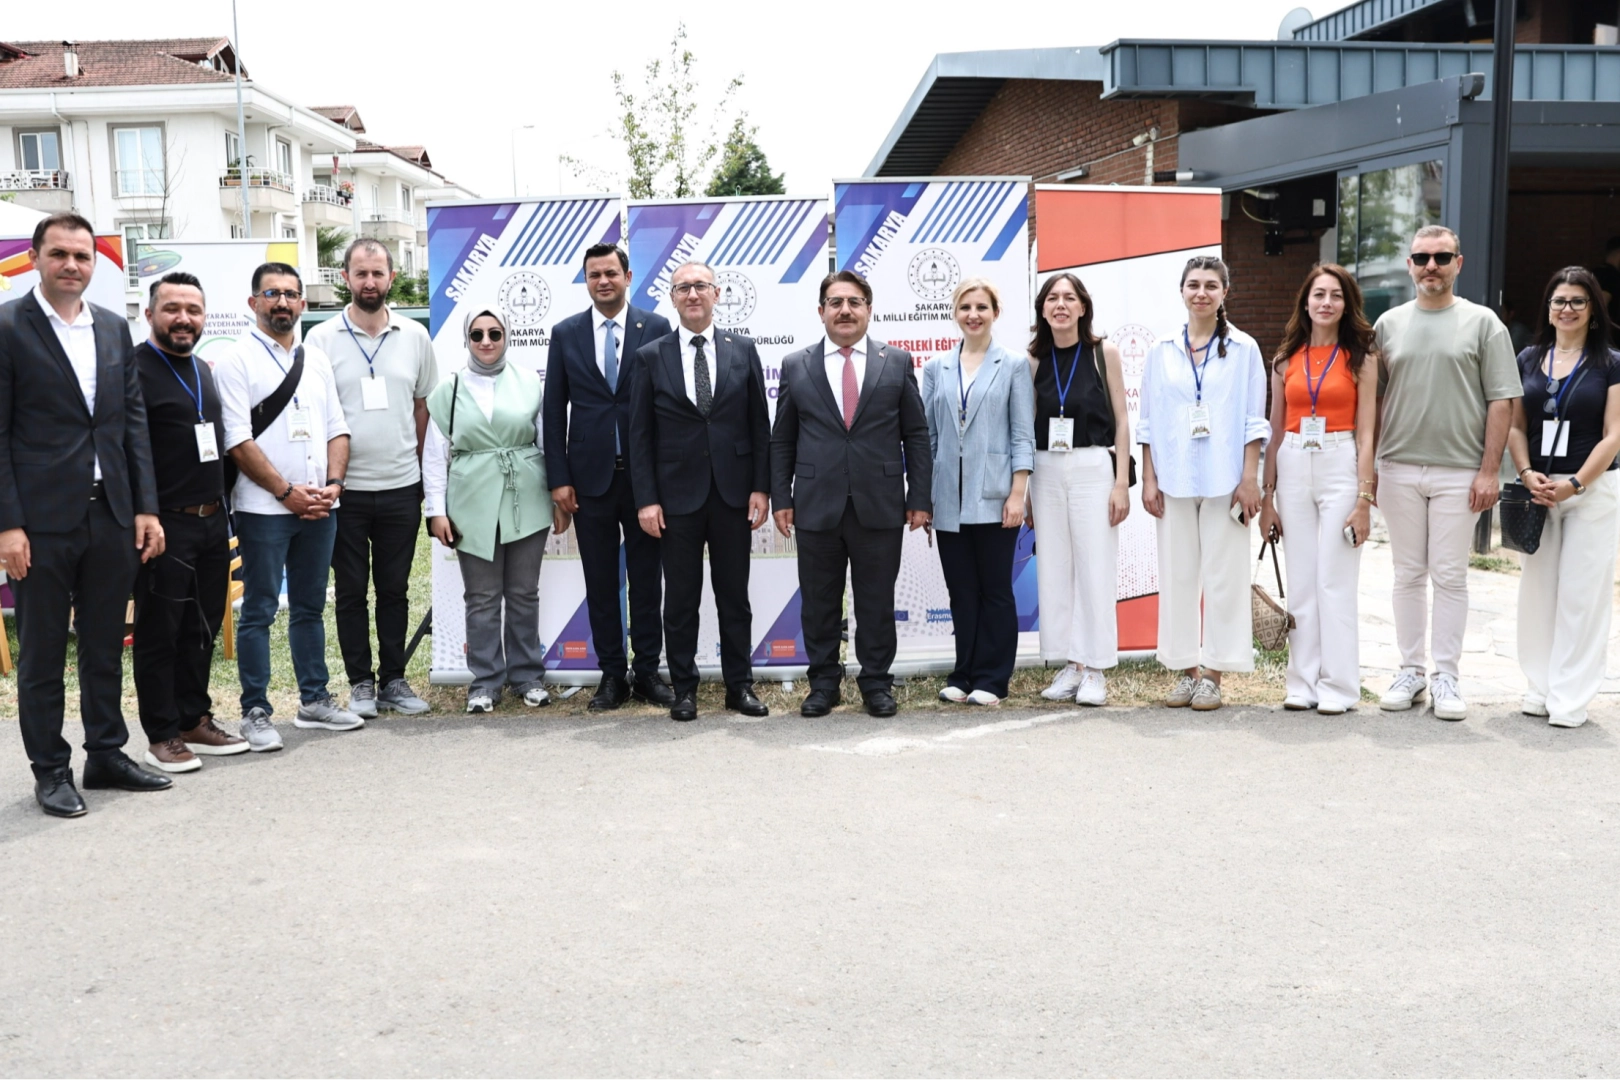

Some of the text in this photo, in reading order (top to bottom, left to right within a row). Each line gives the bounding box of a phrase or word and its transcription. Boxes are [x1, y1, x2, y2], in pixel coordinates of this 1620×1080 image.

[854, 210, 907, 278] SAKARYA
[445, 233, 498, 302] SAKARYA
[646, 232, 701, 301] SAKARYA
[873, 313, 881, 322] İL
[883, 312, 906, 322] MİLLİ
[908, 312, 939, 321] EĞİTİM
[510, 329, 545, 337] AKARYA
[753, 335, 795, 345] DÜRLÜĞÜ
[935, 337, 961, 351] EĞİT
